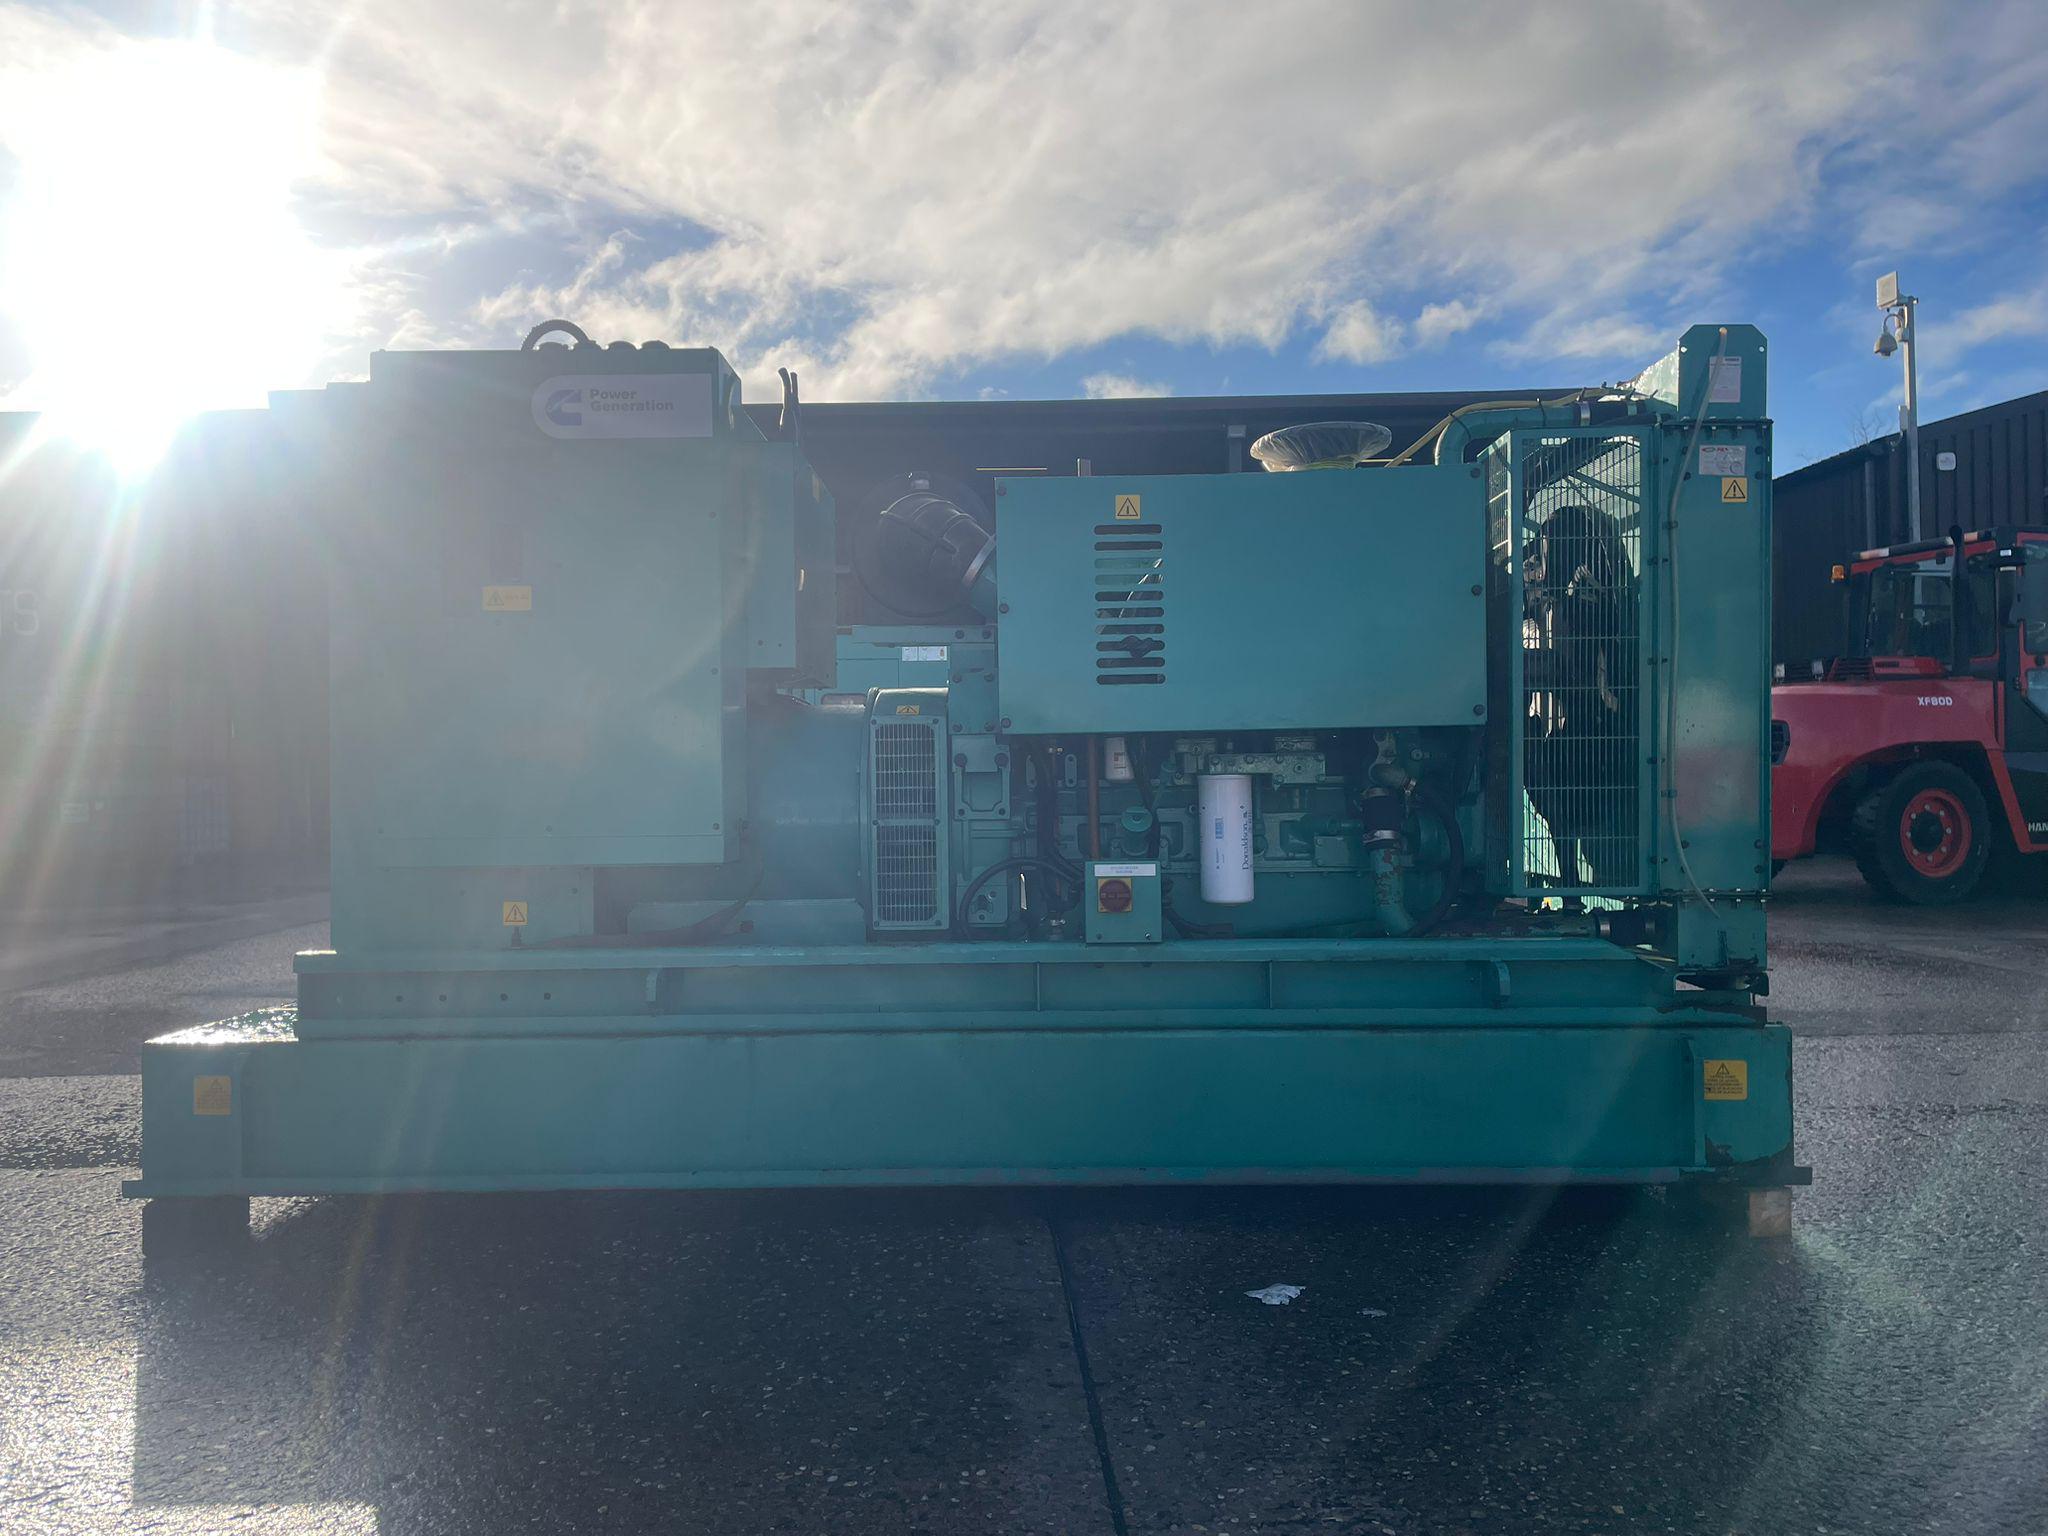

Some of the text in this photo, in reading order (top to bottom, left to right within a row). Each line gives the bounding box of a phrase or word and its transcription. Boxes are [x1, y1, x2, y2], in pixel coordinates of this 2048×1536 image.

[590, 389, 637, 400] Power
[590, 400, 674, 412] Generation
[1917, 696, 1953, 706] XF80D
[1240, 823, 1249, 870] Donaldson
